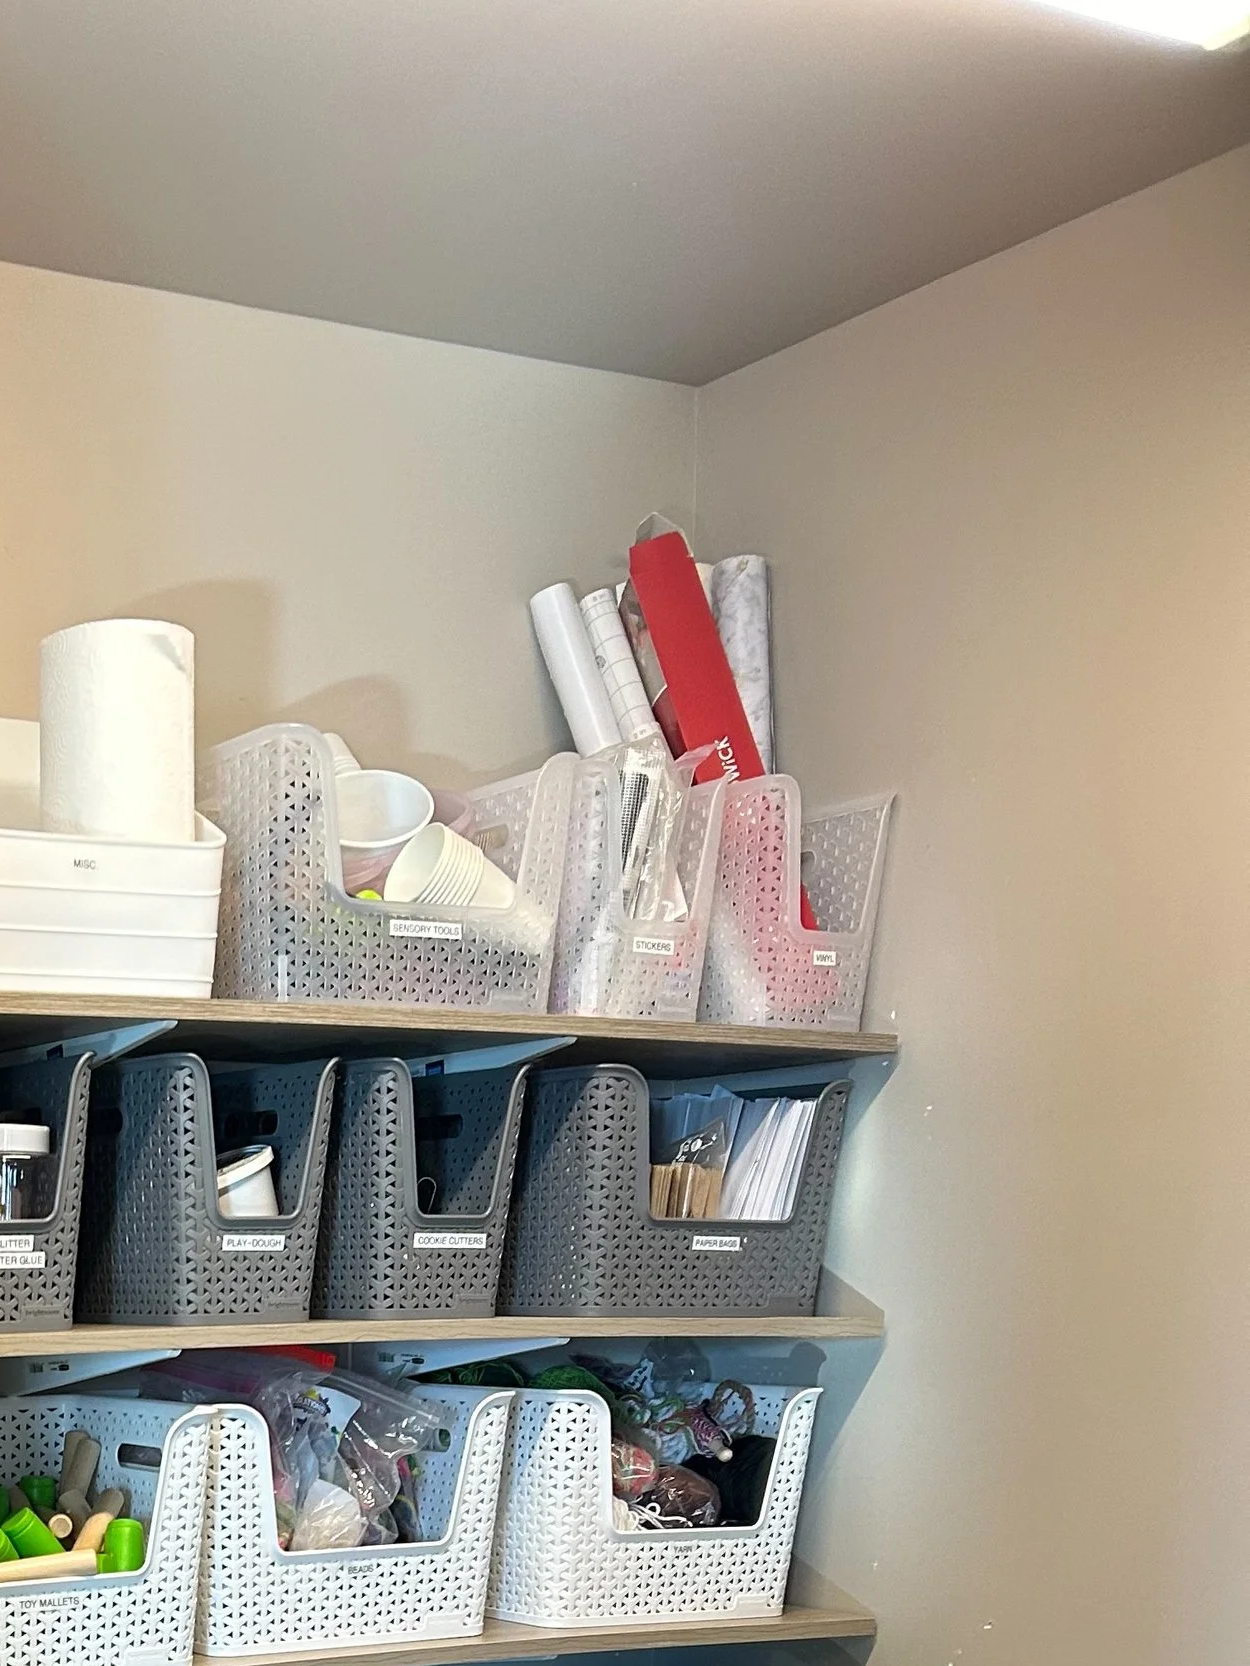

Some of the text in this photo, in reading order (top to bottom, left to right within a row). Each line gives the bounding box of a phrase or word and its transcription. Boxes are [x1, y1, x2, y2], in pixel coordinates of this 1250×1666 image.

[392, 922, 460, 937] SENSORY TOOLS
[635, 941, 671, 953] STICKERS
[815, 952, 834, 964] VINYL
[226, 1238, 282, 1248] PLAY-DOUGH
[417, 1235, 484, 1246] COOKIE CUTTERS
[695, 1239, 738, 1248] PAPER BAGS
[18, 1255, 43, 1265] GLUE
[674, 1545, 693, 1554] YARN
[348, 1564, 374, 1575] BEADS
[19, 1596, 80, 1609] TOY MALLETS
